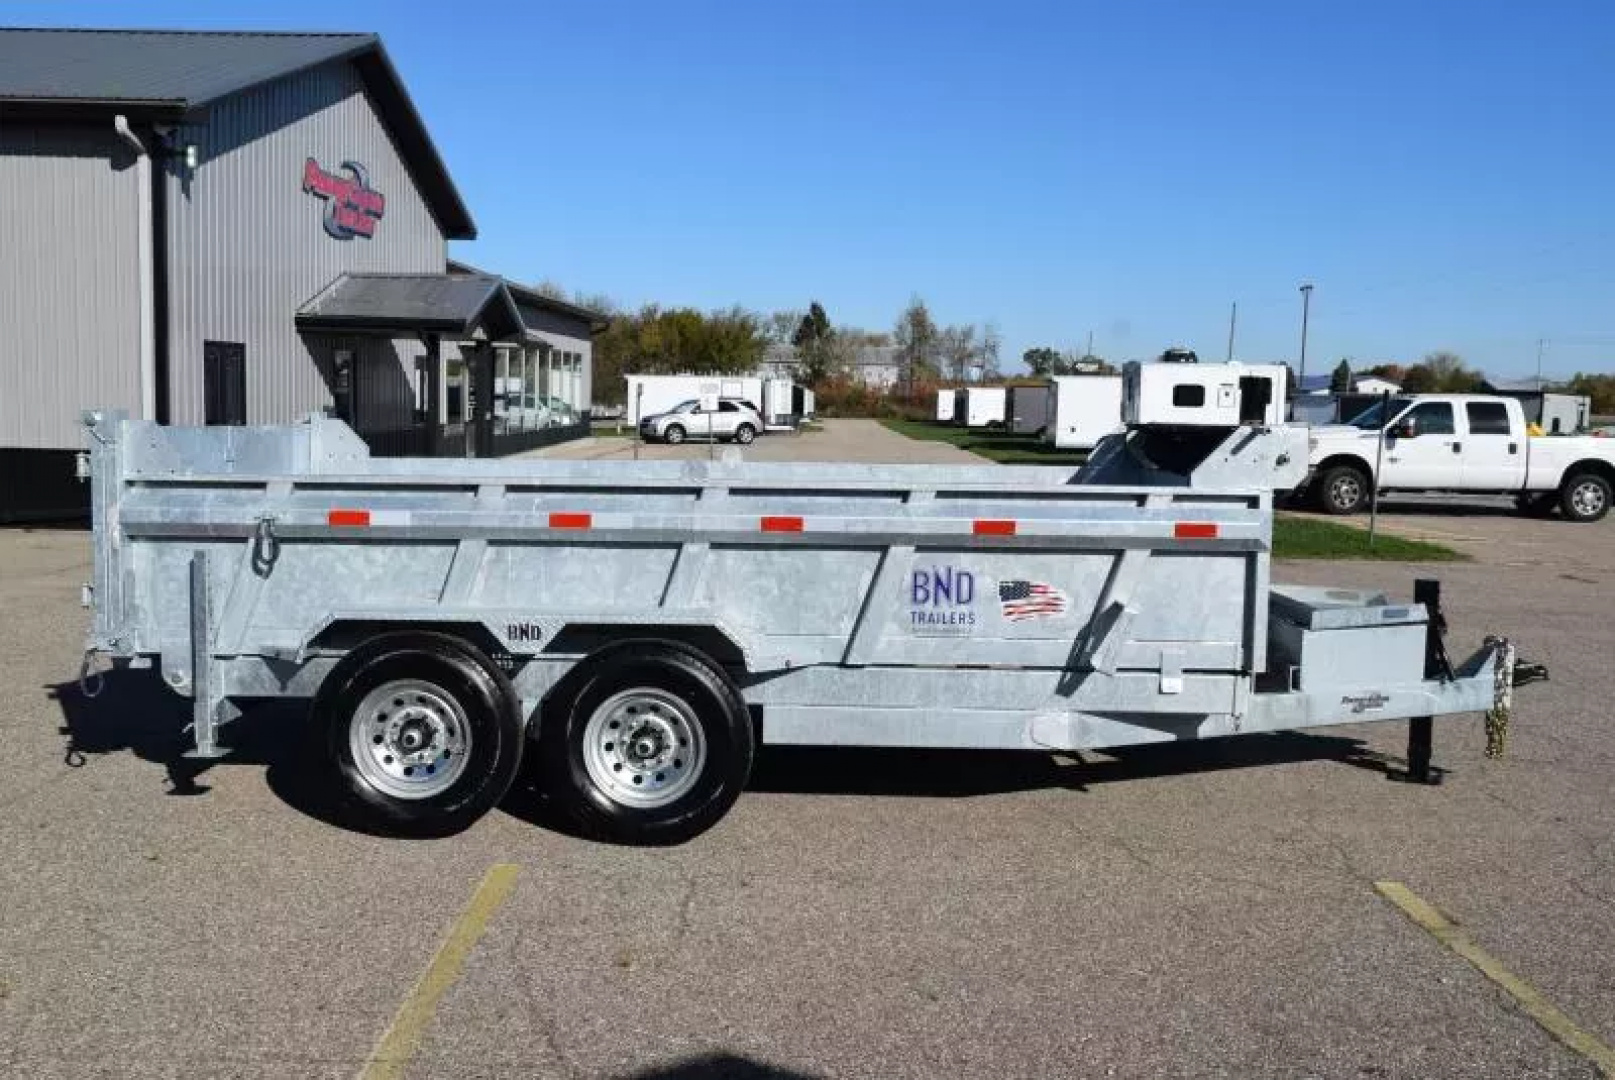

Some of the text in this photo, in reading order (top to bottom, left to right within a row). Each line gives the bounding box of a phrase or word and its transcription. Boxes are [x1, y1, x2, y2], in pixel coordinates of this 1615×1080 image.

[912, 565, 975, 607] BND
[910, 611, 976, 625] TRAILERS
[508, 624, 542, 641] BND
